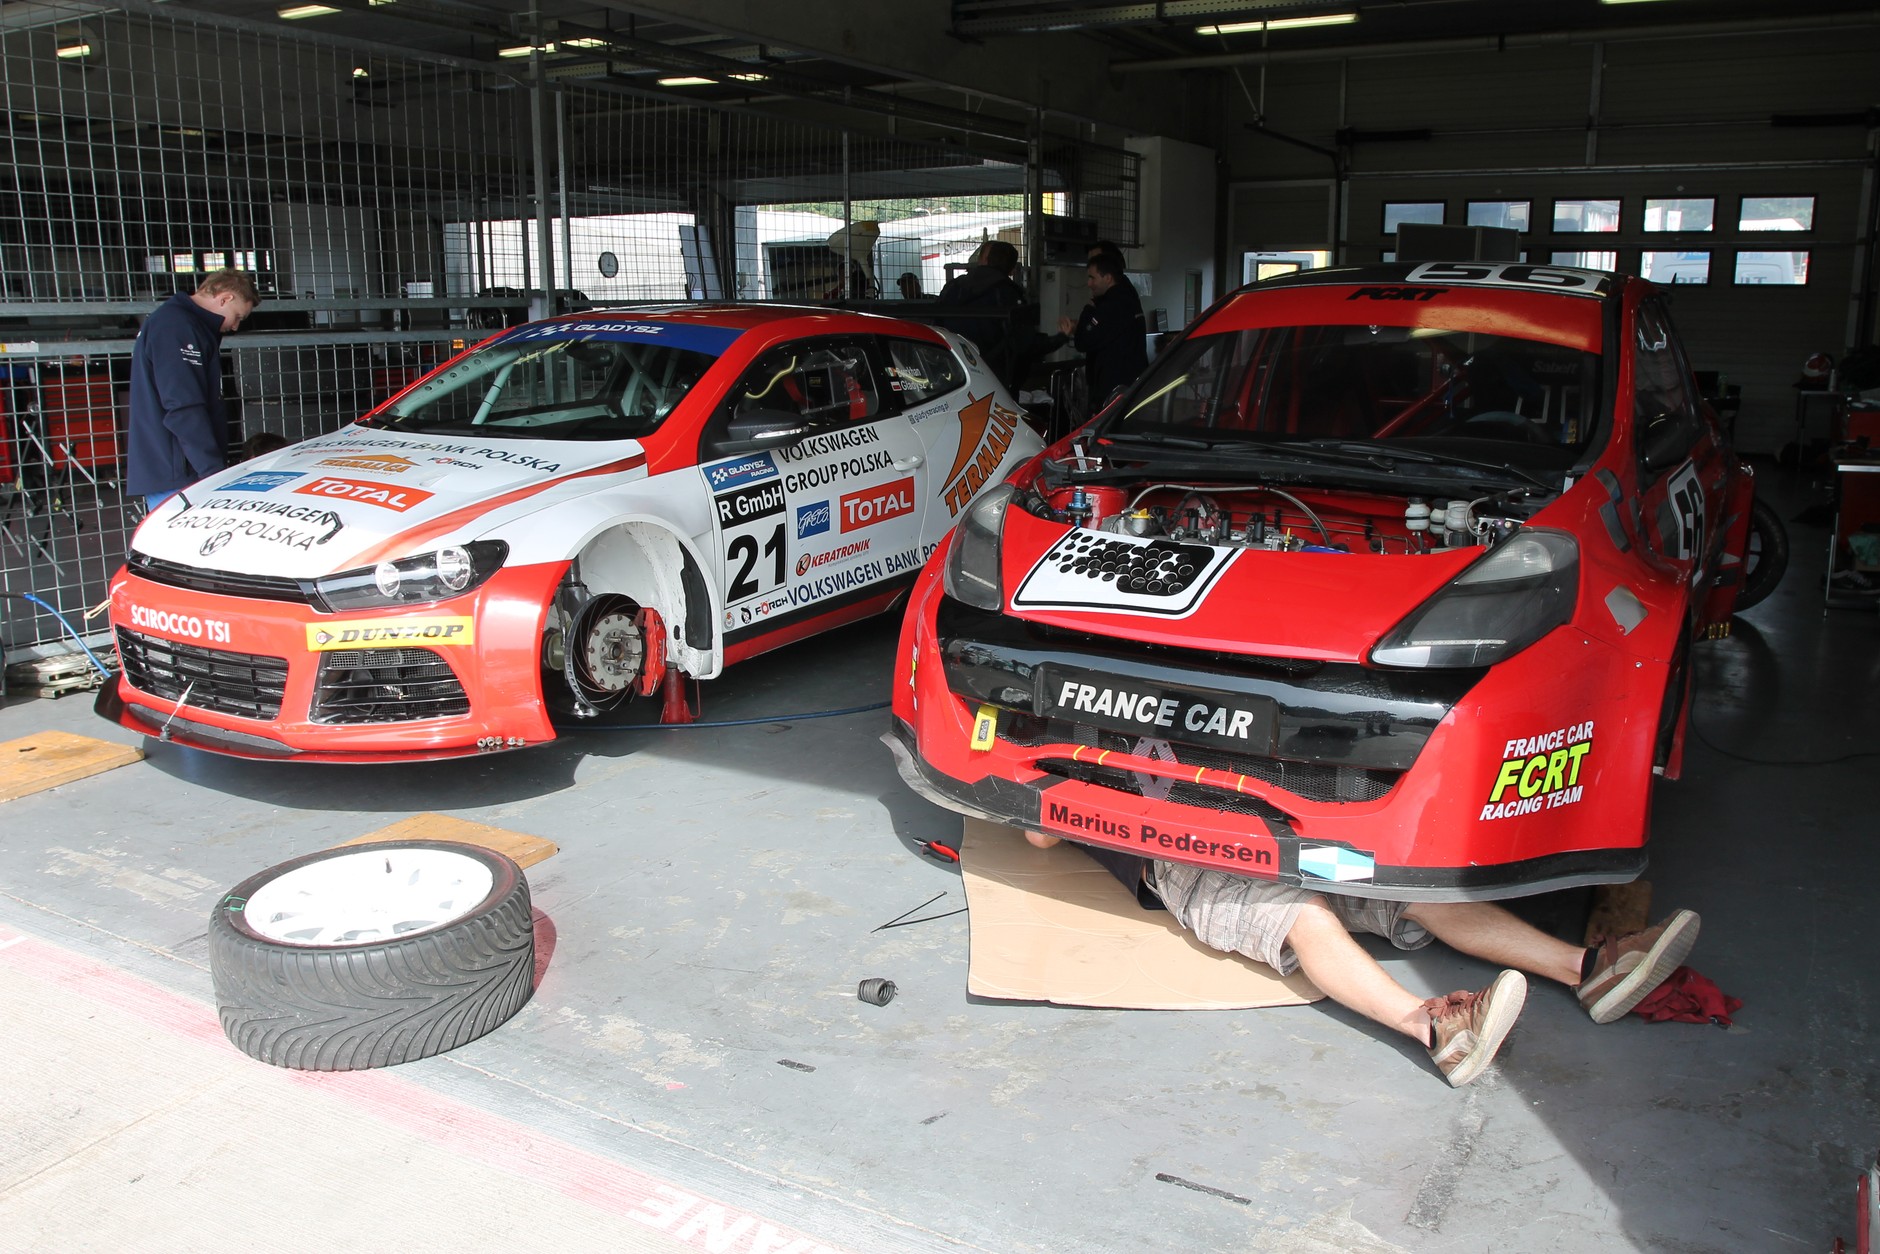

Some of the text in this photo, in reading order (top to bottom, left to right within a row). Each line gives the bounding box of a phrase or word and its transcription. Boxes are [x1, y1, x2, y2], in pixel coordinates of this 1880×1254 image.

[1417, 262, 1587, 288] 56
[292, 438, 562, 474] VOLKSWAGEN BANK POLSKA
[778, 426, 880, 464] VOLKSWAGEN
[750, 467, 775, 478] RACING
[785, 450, 894, 494] GROUP POLSKA
[310, 479, 410, 508] TOTAL
[718, 485, 785, 522] R GmbH
[844, 490, 912, 524] TOTAL
[201, 498, 333, 526] VOLKSWAGEN
[168, 515, 316, 551] GROUP POLSKA
[726, 522, 786, 604] 21
[811, 538, 871, 568] KERATRONIK
[787, 560, 883, 607] VOLKSWAGEN
[887, 549, 921, 574] BANK
[131, 604, 231, 644] SCIROCCO TSI
[338, 624, 465, 643] DUNLOP
[1058, 681, 1254, 739] FRANCE CAR
[1503, 720, 1594, 759] FRANCE CAR
[1489, 742, 1591, 802] FCRT
[1479, 785, 1584, 821] RACING TEAM
[1050, 802, 1272, 866] Marius Pedersen
